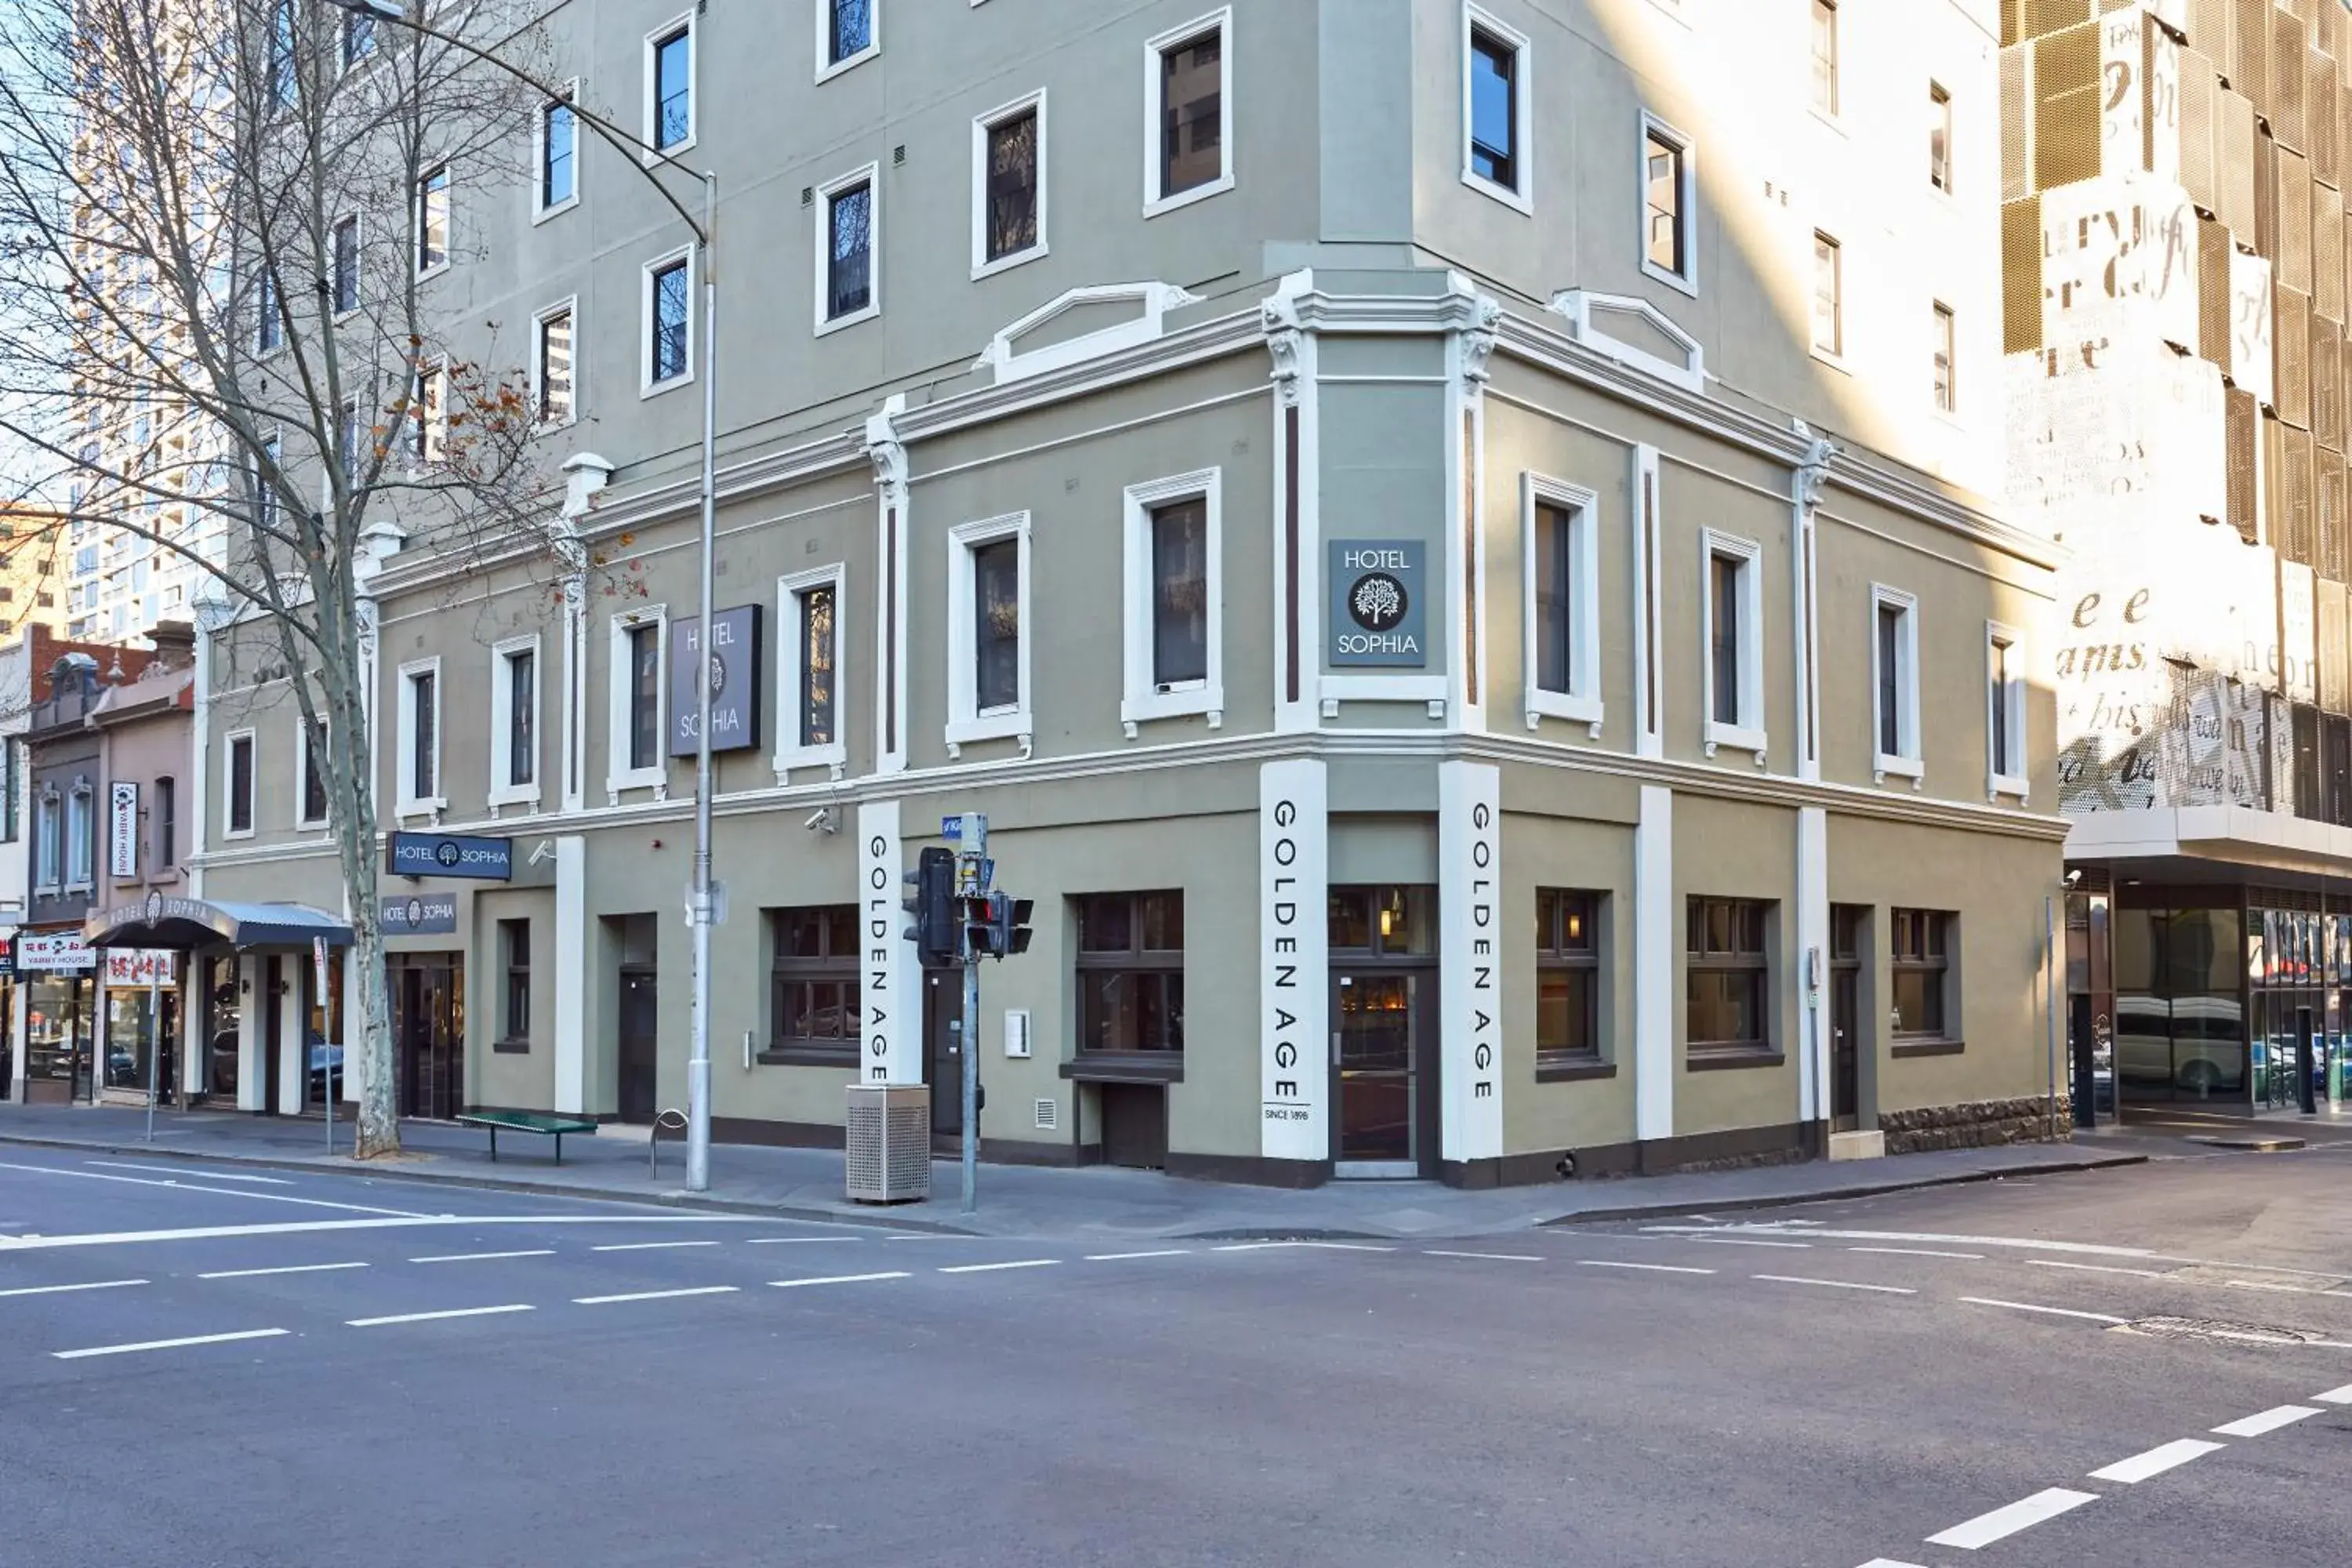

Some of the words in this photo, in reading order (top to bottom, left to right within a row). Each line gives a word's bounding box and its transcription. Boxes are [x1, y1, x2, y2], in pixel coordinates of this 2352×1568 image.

[1344, 550, 1410, 568] HOTEL
[687, 622, 735, 652] HTEL
[1338, 634, 1418, 654] SOPHIA
[118, 843, 128, 875] HOUSE
[395, 846, 434, 860] HOTEL
[461, 849, 509, 864] SOPHIA
[1274, 800, 1297, 988] GOLDEN
[1472, 802, 1490, 989] GOLDEN
[110, 904, 141, 925] HOTEL
[167, 899, 207, 920] SOPHIA
[383, 907, 406, 921] HOTEL
[422, 904, 454, 920] SOPHIA
[870, 835, 887, 990] GOLDEN
[58, 956, 88, 964] HOUSE
[871, 1007, 887, 1080] AGE
[1274, 1007, 1298, 1098] AGE
[1473, 1009, 1492, 1098] AGE
[1265, 1109, 1288, 1120] SINCE
